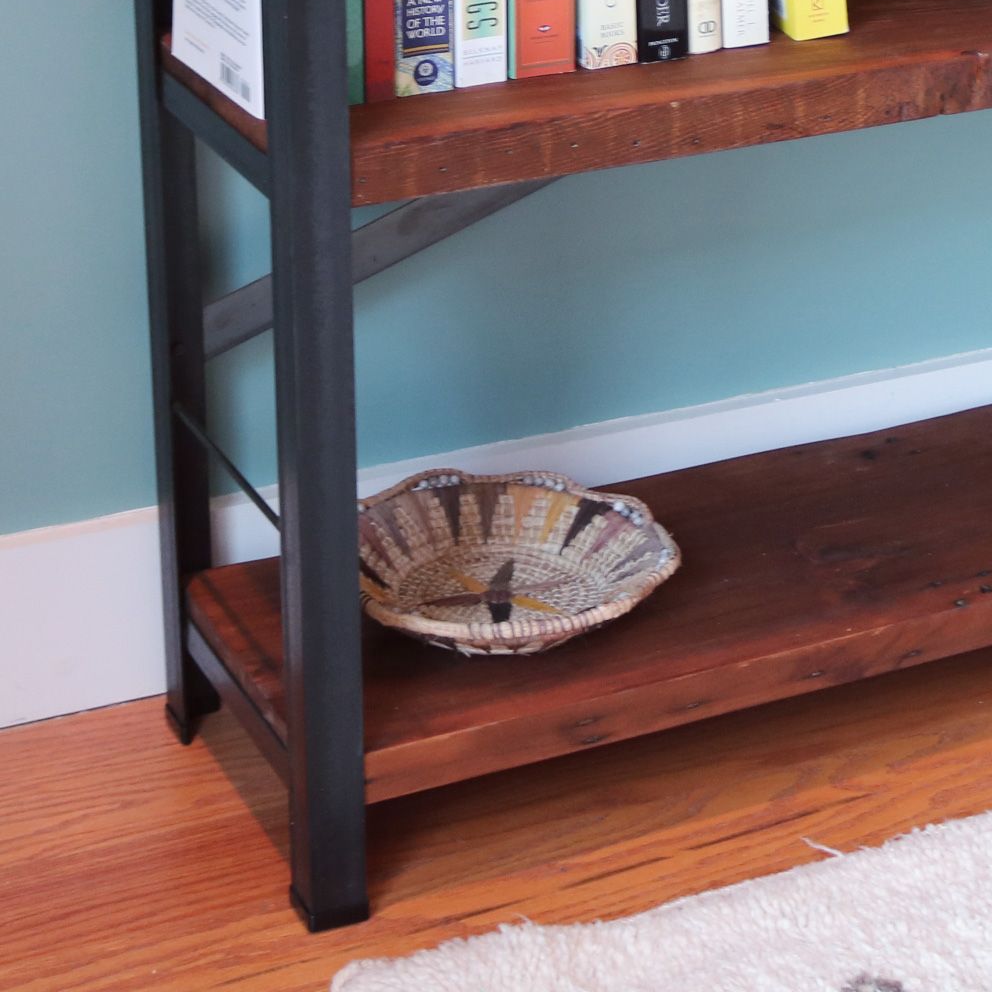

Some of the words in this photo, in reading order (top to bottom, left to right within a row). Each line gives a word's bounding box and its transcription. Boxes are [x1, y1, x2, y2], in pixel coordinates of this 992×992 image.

[406, 5, 446, 17] HISTORY
[406, 19, 421, 29] OF
[422, 15, 446, 27] THE
[405, 26, 446, 39] WORLD
